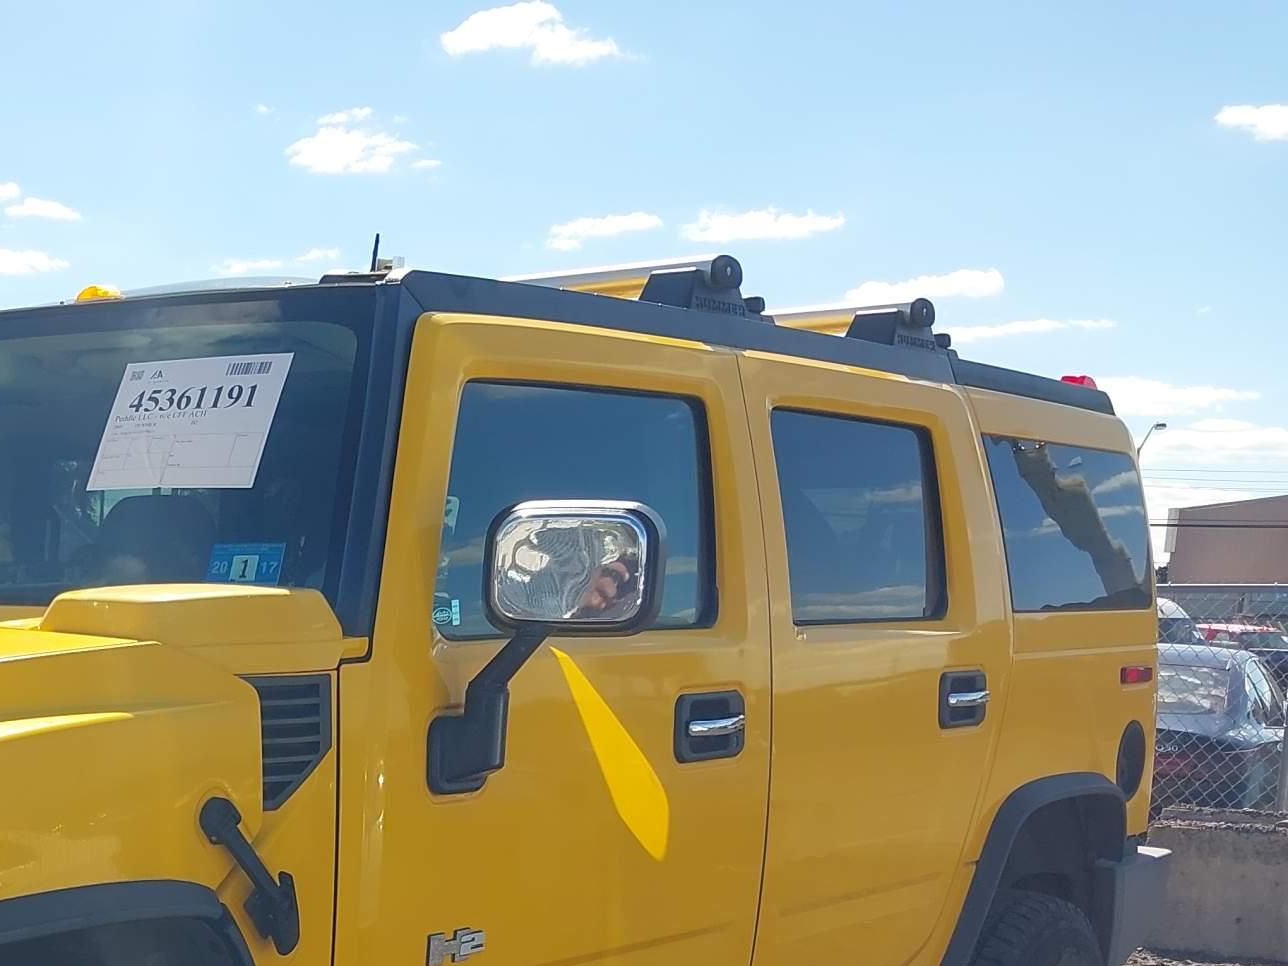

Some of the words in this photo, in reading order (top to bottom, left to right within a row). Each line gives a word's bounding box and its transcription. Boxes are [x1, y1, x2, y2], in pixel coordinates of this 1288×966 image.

[128, 384, 258, 413] 45361191
[212, 561, 229, 574] 20
[238, 559, 249, 578] 1
[261, 561, 279, 575] 17
